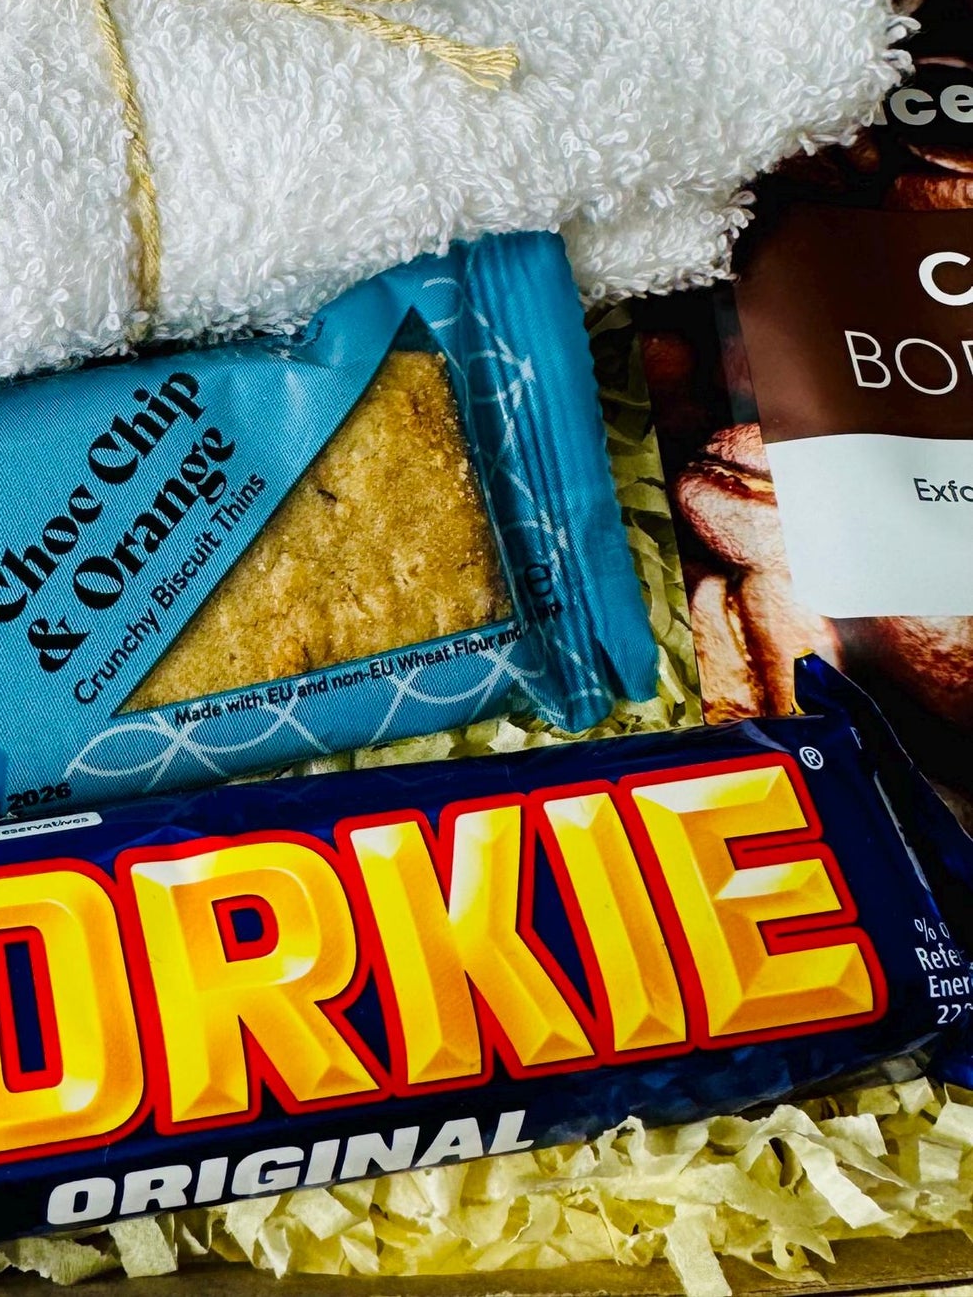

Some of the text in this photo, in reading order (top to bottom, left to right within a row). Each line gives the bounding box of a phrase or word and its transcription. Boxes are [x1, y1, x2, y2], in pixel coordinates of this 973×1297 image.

[844, 330, 973, 395] BO
[88, 371, 207, 485] Chip
[27, 426, 236, 674] & Orange
[73, 471, 267, 705] Crunchy Biscuit Thins
[176, 702, 223, 726] Made
[226, 691, 265, 714] with
[267, 681, 294, 704] EU
[297, 676, 328, 699] and
[331, 658, 395, 691] non-EU
[397, 646, 451, 674] Wheat
[453, 635, 496, 656] Flour
[5, 781, 72, 811] 2026
[928, 974, 973, 998] Ener
[47, 1109, 535, 1226] ORIGINAL
